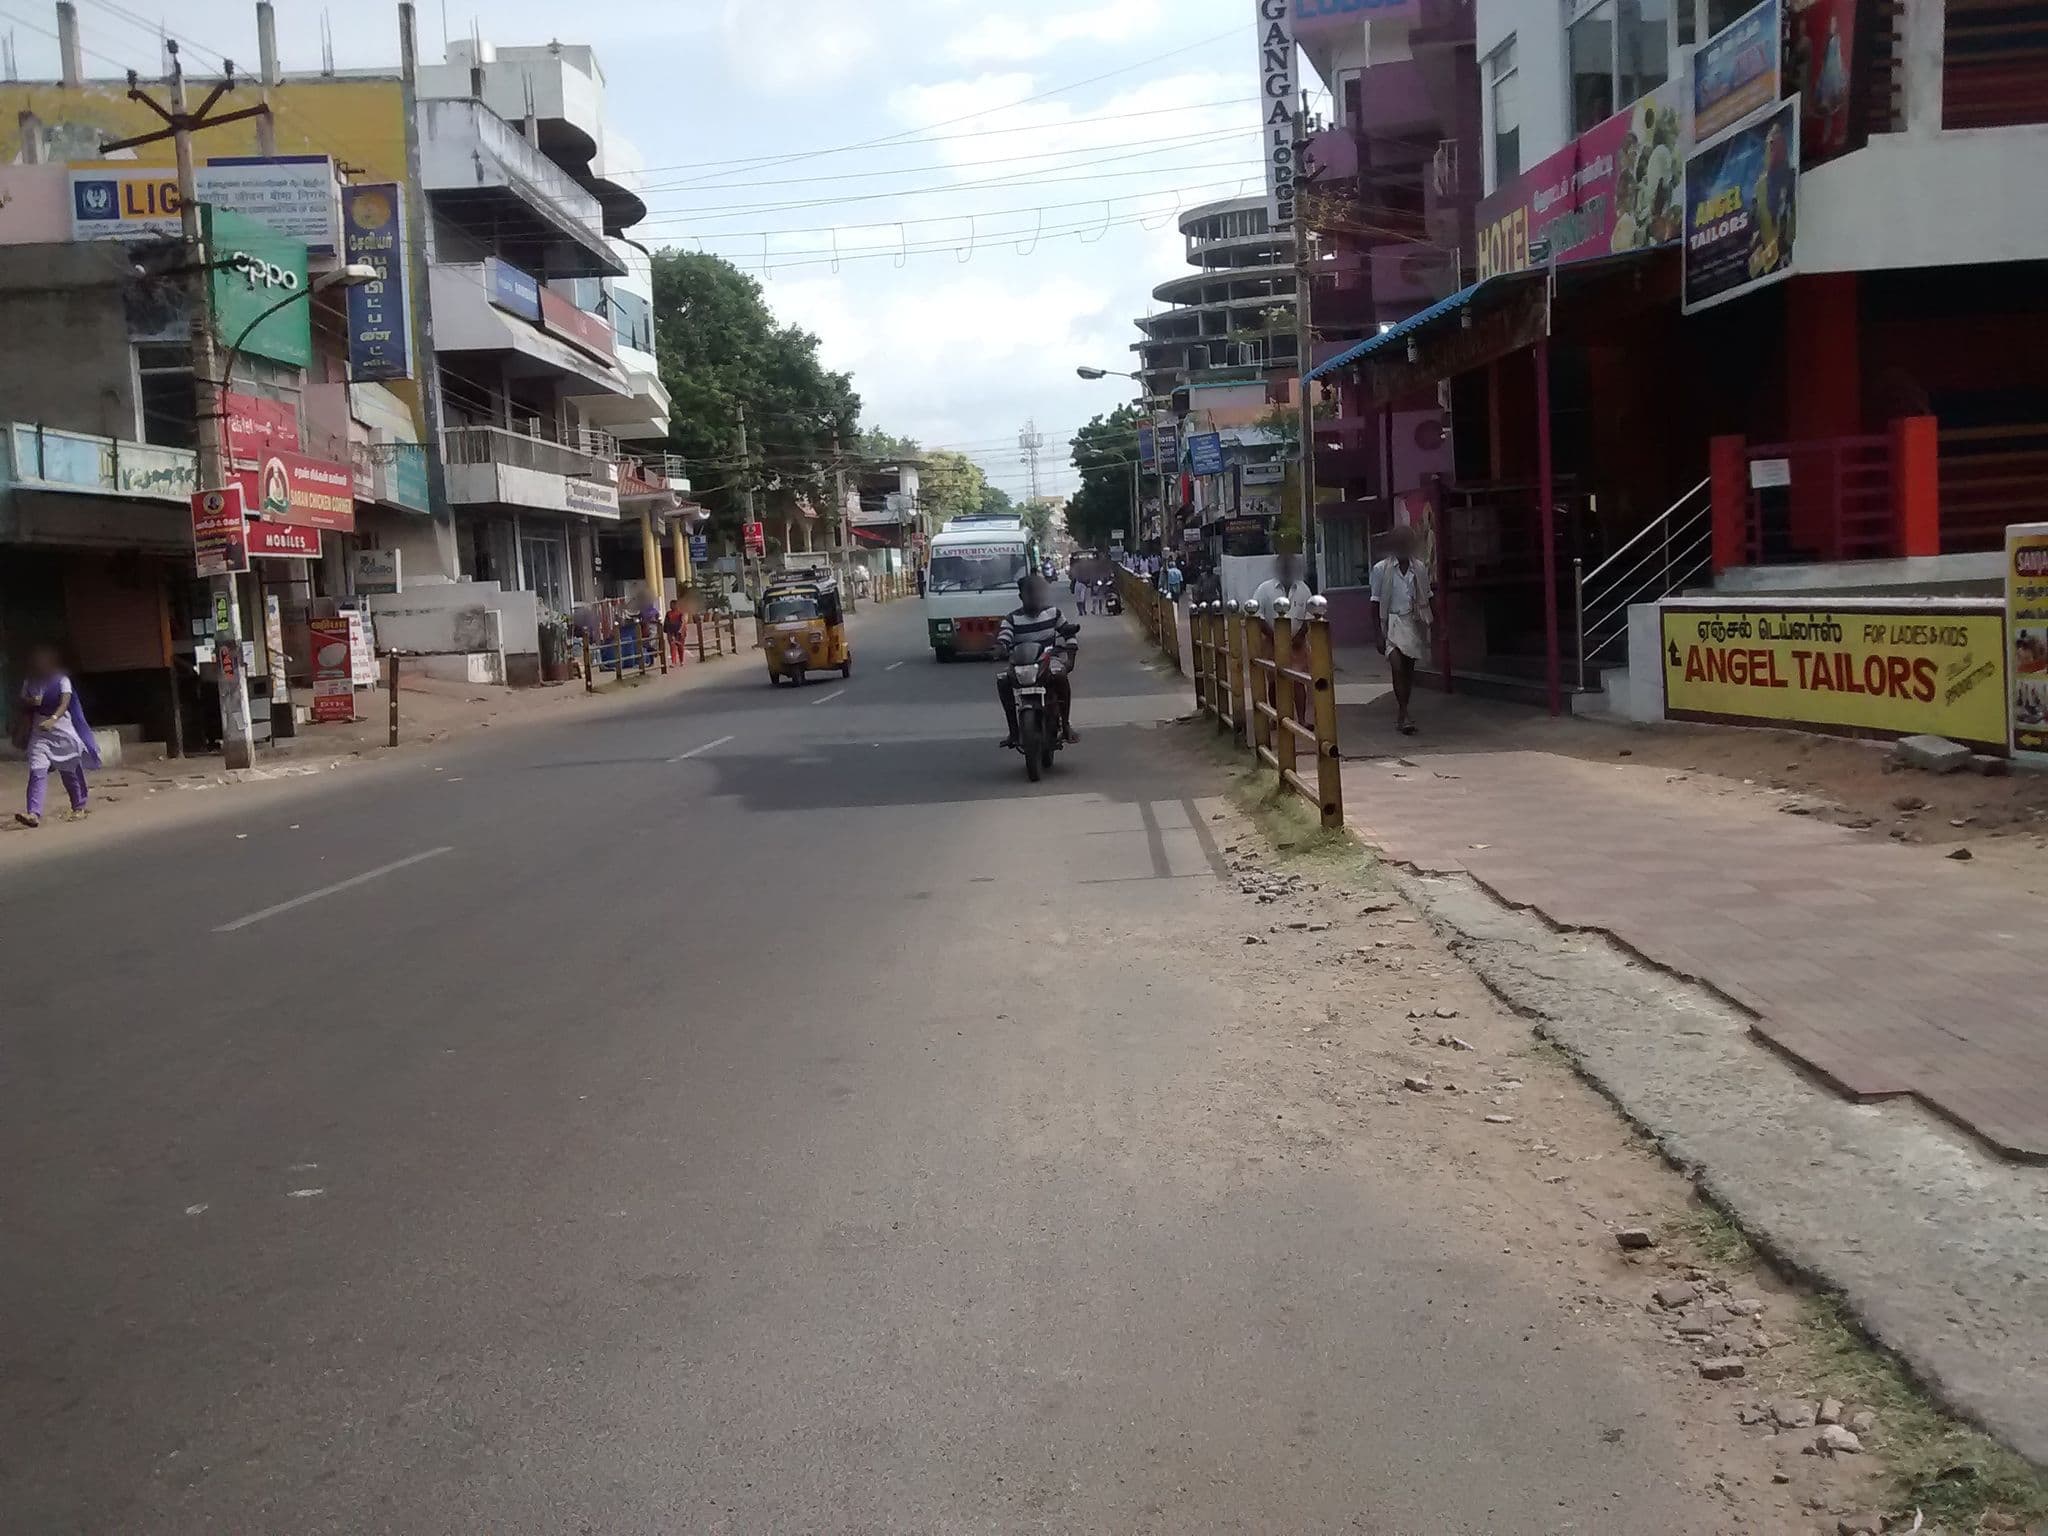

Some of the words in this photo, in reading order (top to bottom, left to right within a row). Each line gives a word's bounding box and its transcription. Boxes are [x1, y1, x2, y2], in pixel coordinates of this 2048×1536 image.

[1261, 0, 1293, 124] GANGA
[1273, 130, 1295, 220] LODGE
[1690, 212, 1748, 250] TAILORS
[1863, 624, 1886, 643] FOR
[1685, 645, 1788, 689] ANGEL
[1791, 650, 1939, 703] TAILORS
